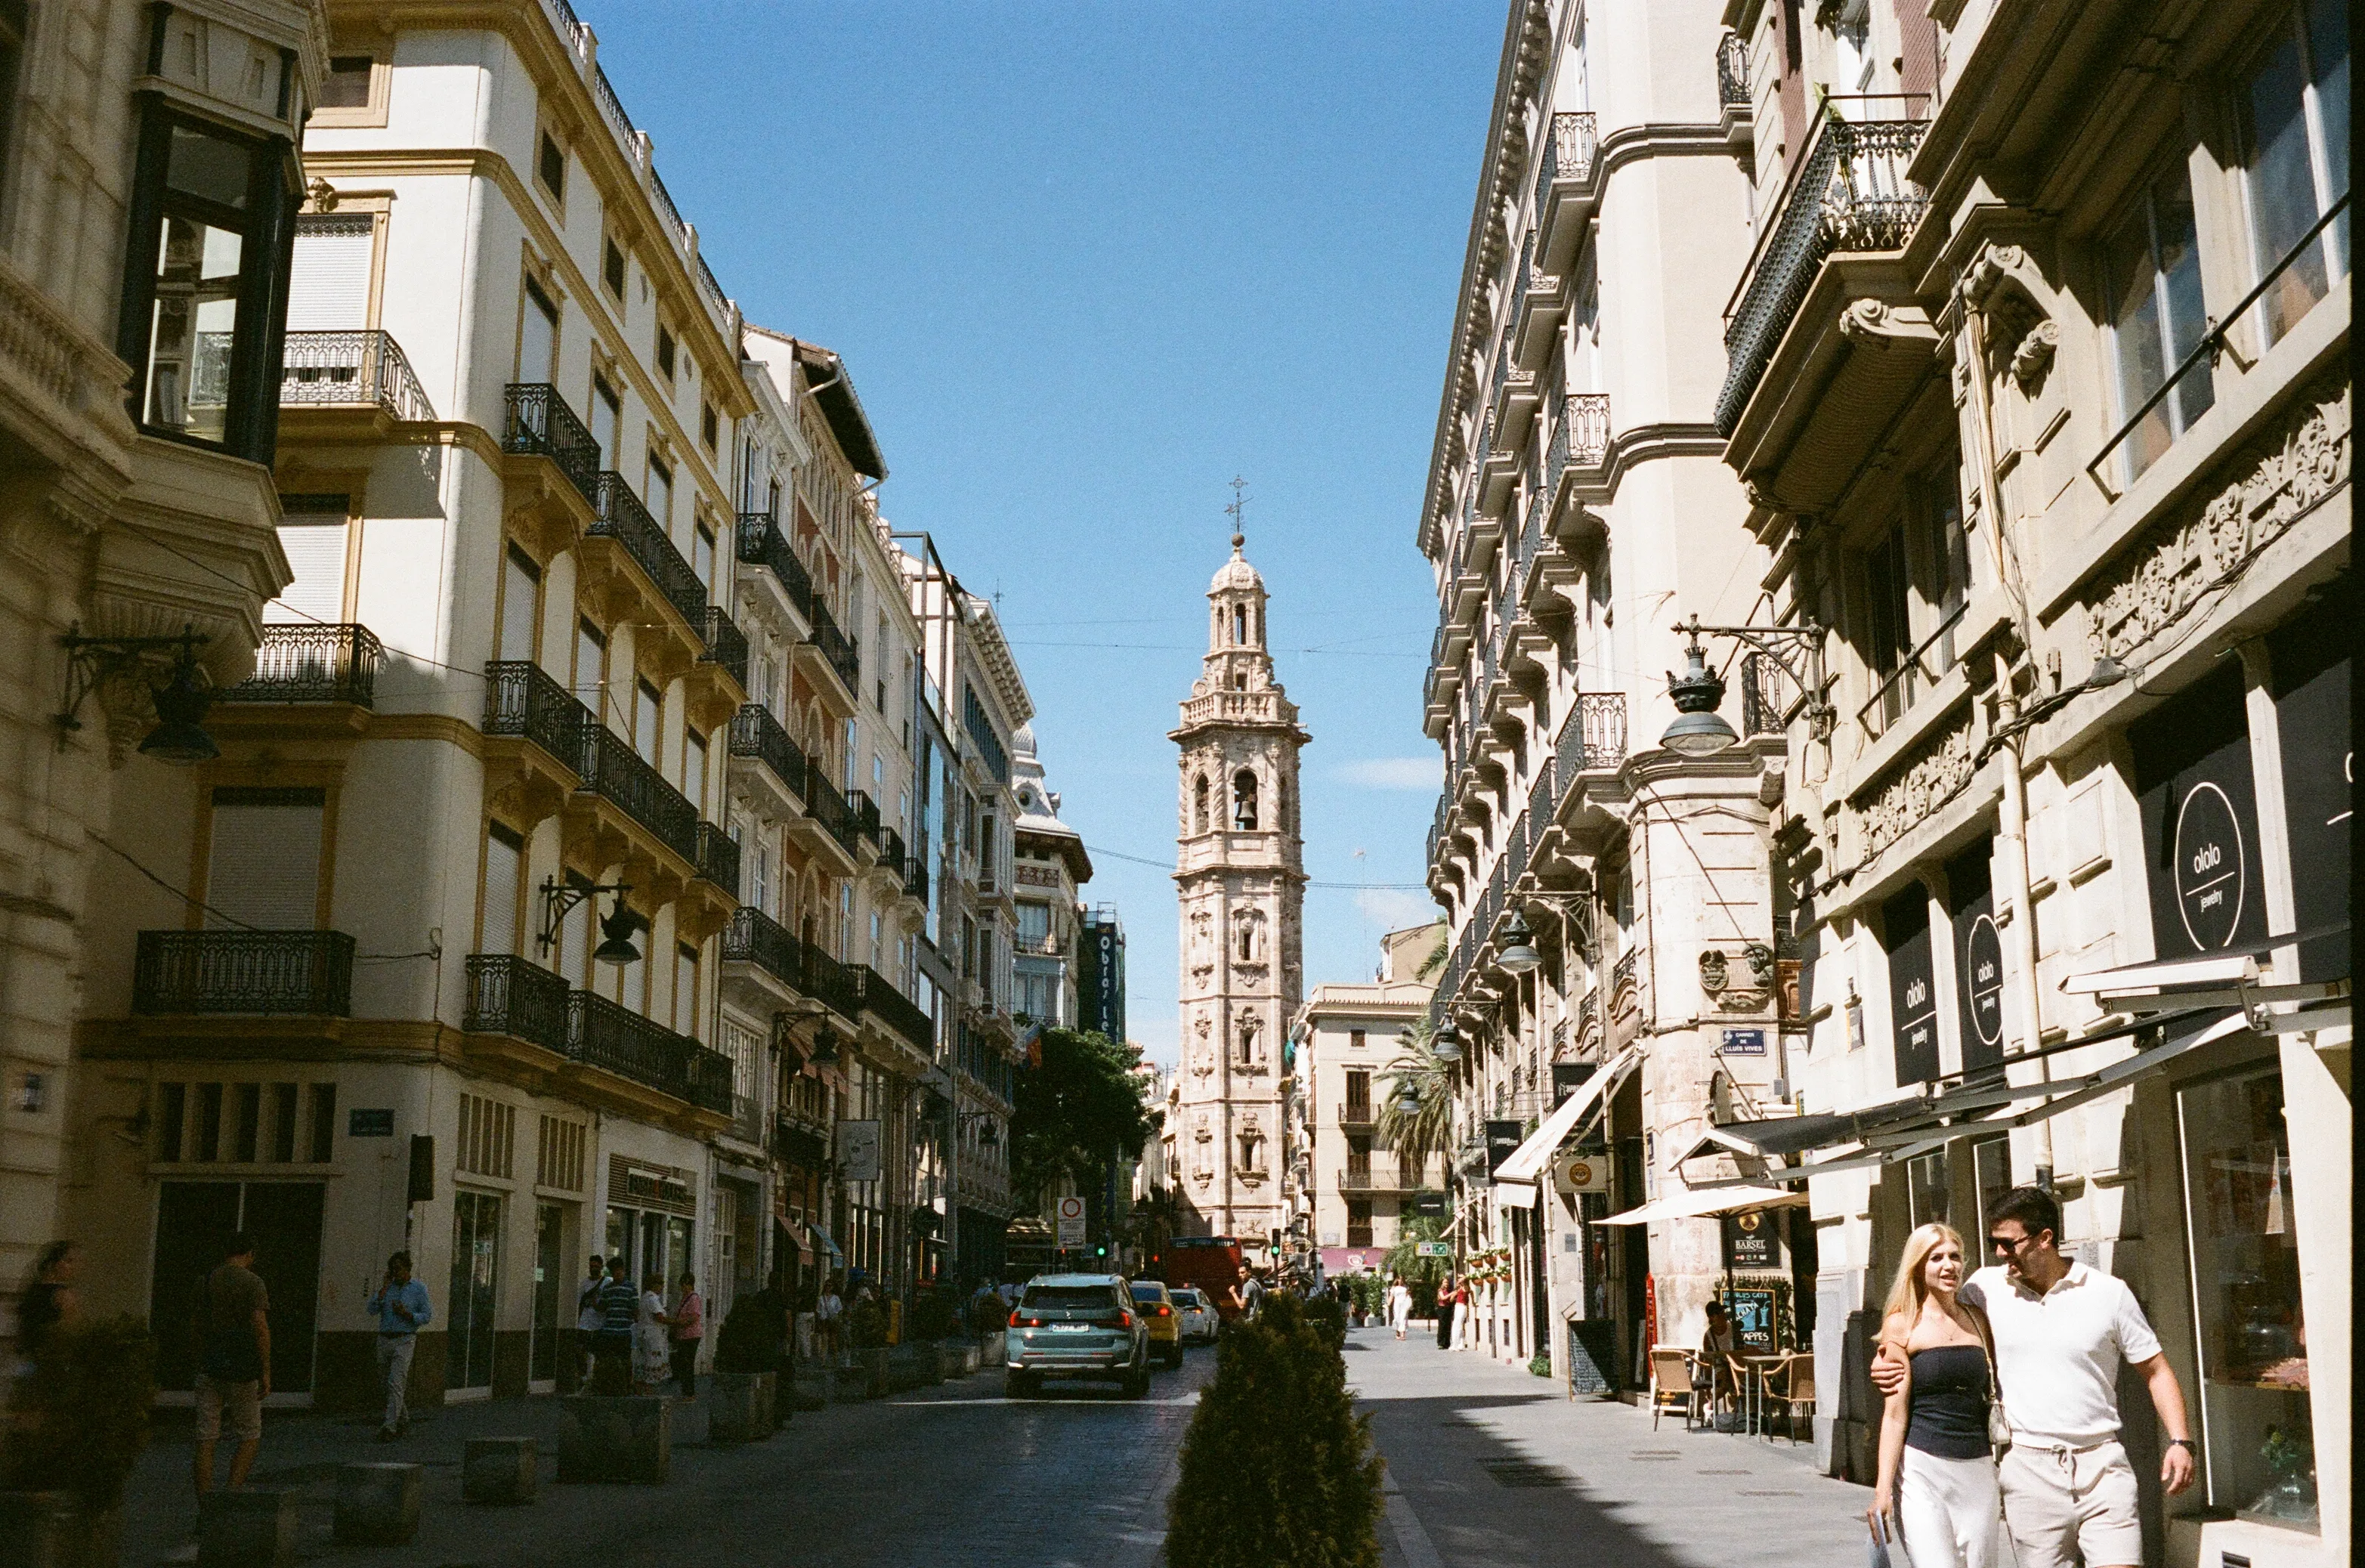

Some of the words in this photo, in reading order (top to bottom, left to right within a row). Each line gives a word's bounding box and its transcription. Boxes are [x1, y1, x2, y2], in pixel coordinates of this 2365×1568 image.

[2193, 843, 2221, 874] ololo
[2200, 889, 2223, 913] jewelry
[1978, 960, 1994, 982] ololo
[1907, 978, 1926, 1009] ololo
[1911, 1027, 1928, 1050] jewelry
[1736, 1240, 1766, 1250] BARSEL
